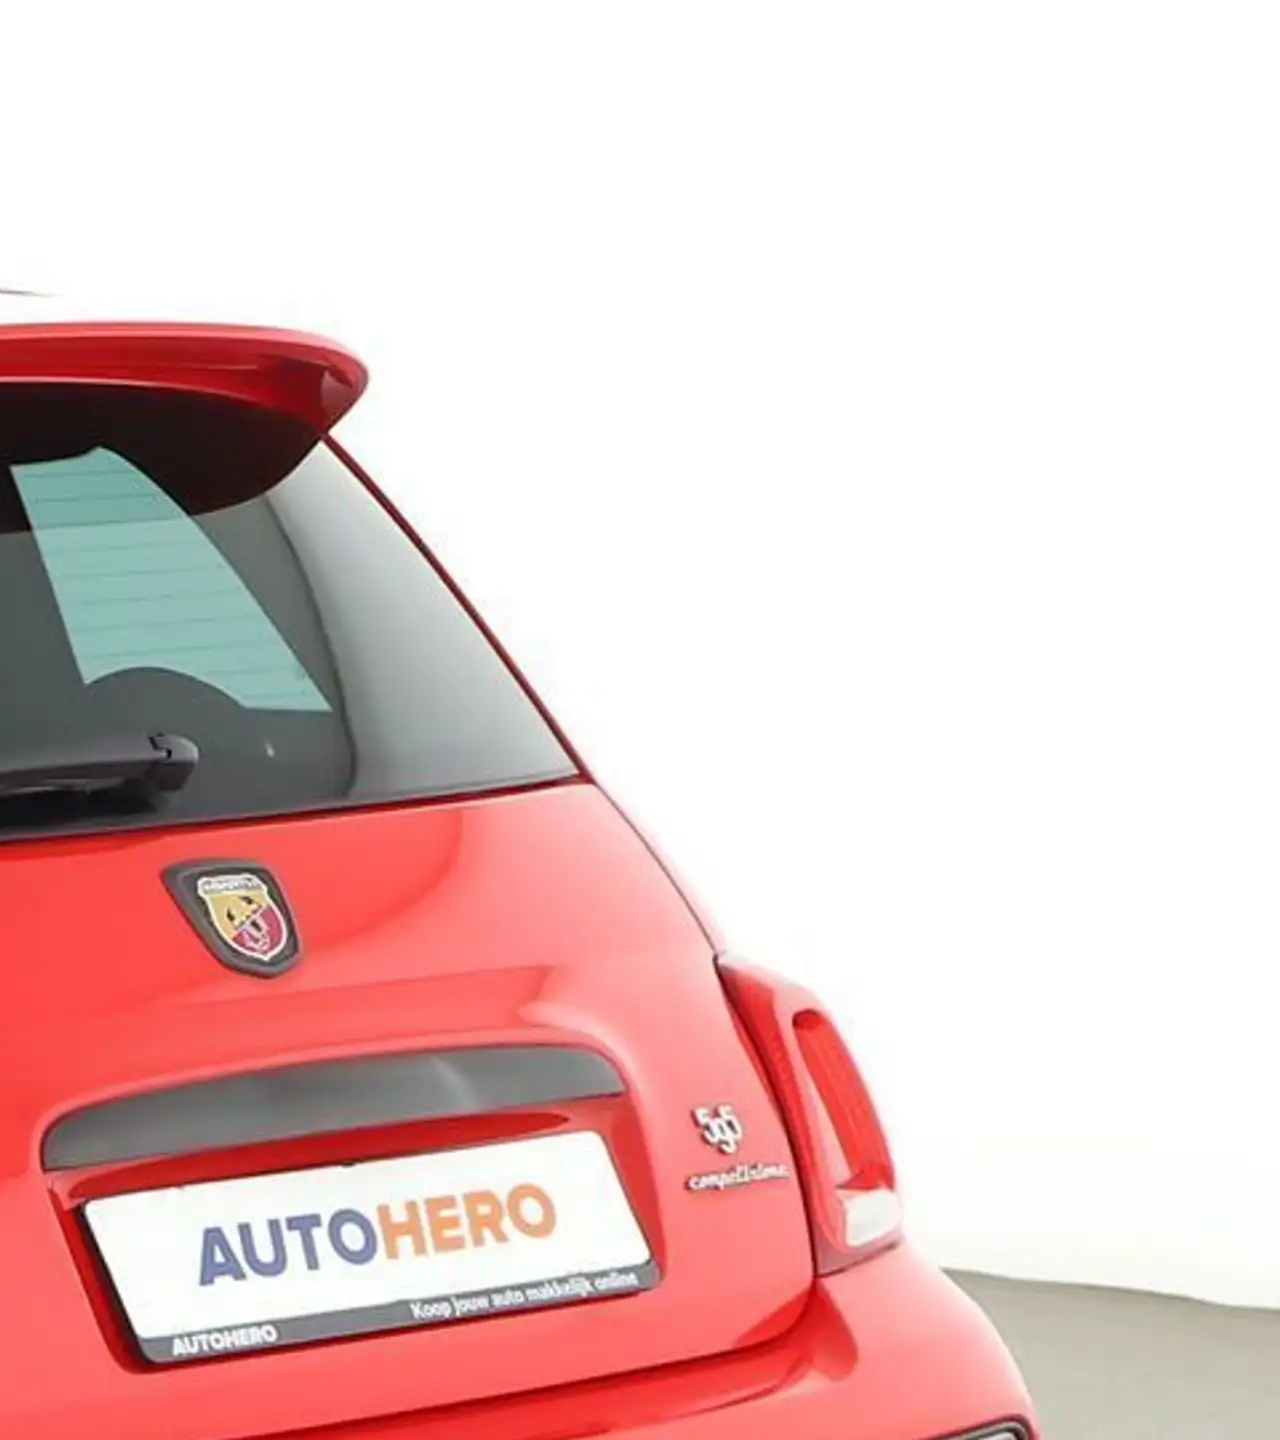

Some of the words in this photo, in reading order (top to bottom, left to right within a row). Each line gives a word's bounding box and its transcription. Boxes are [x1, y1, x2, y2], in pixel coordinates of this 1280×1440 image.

[198, 1183, 556, 1286] AUTOHERO
[409, 1301, 451, 1320] Koop
[451, 1296, 490, 1316] jouw
[491, 1289, 525, 1307] auto
[526, 1275, 595, 1301] makkelijk
[593, 1271, 639, 1290] online
[171, 1323, 279, 1356] AUTOHERO
